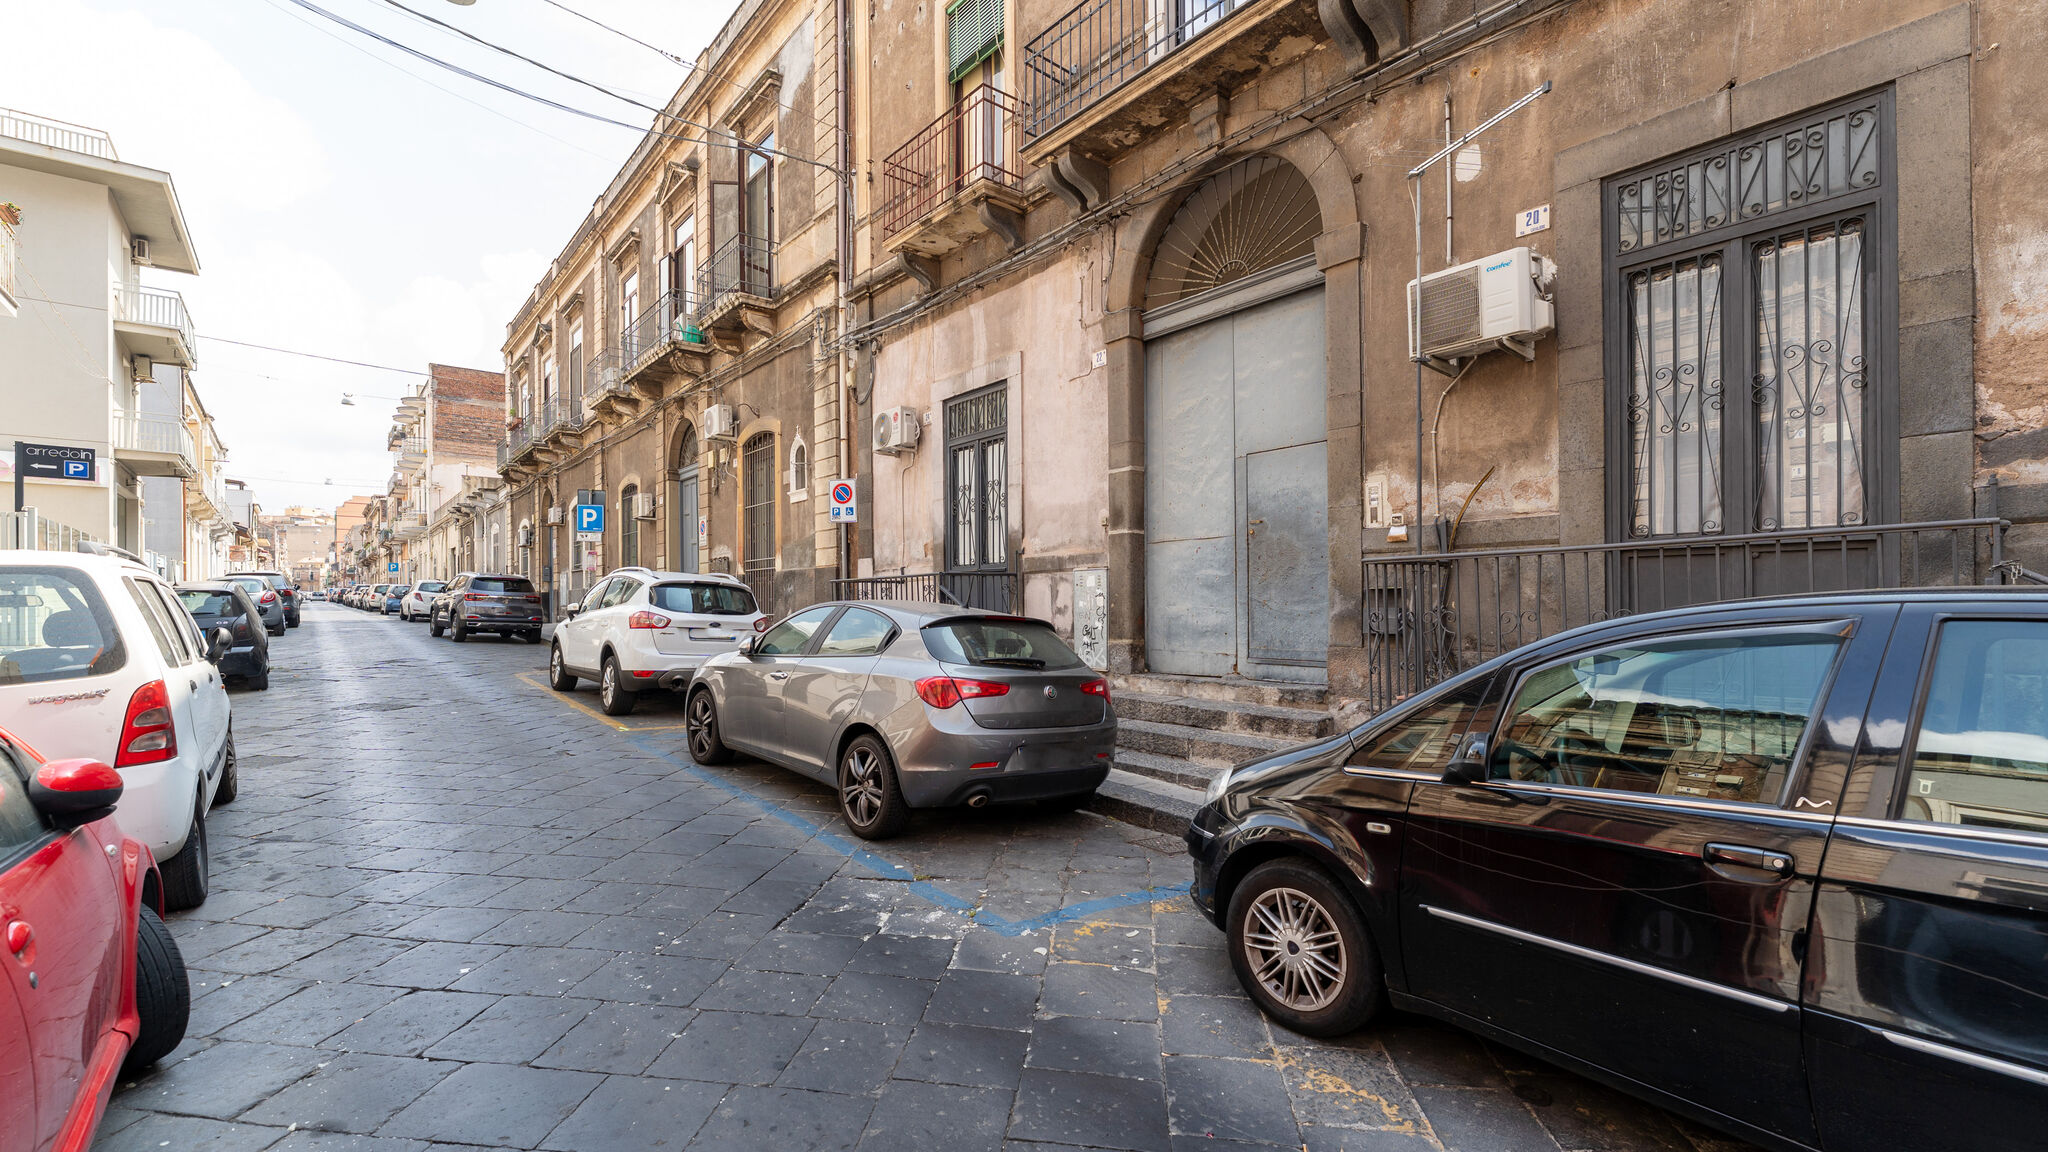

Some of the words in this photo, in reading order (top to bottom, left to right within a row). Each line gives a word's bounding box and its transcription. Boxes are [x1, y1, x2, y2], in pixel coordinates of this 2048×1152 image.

[1526, 209, 1540, 227] 20
[26, 447, 92, 460] arredoin
[69, 463, 84, 475] P
[583, 508, 597, 528] P
